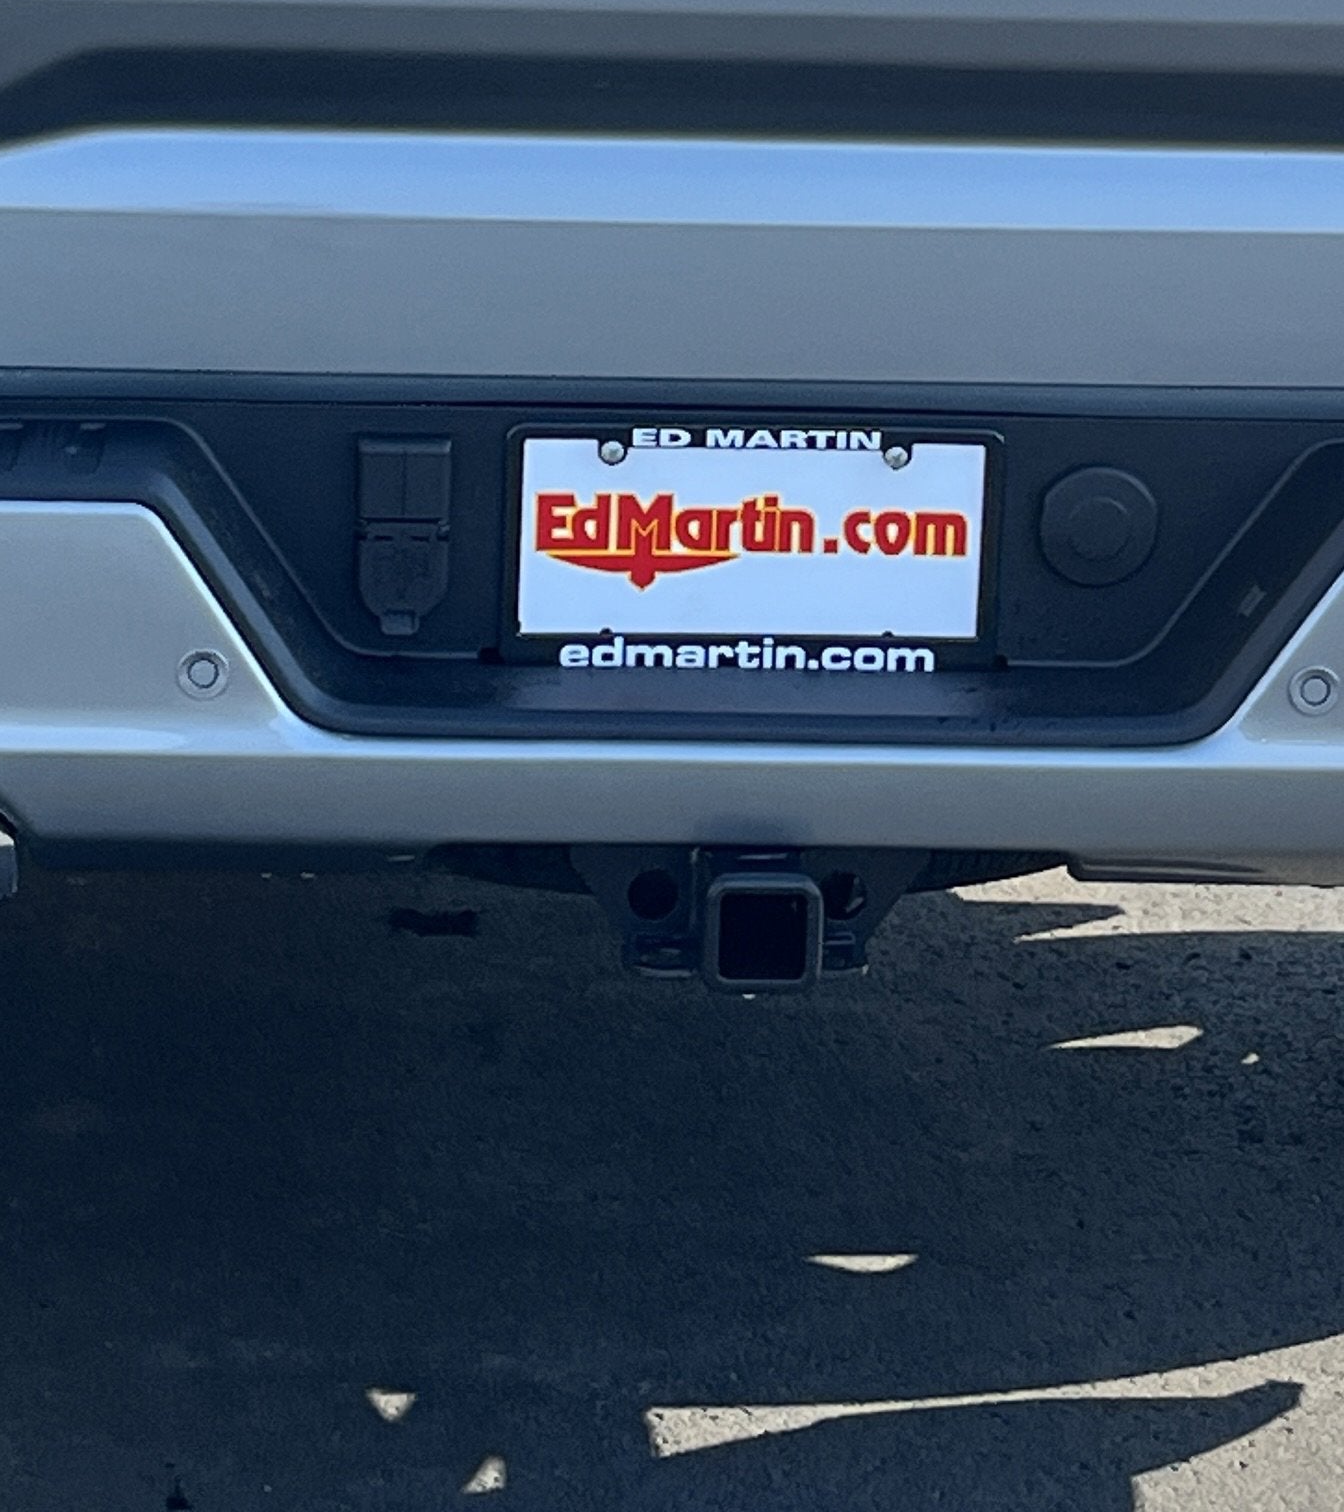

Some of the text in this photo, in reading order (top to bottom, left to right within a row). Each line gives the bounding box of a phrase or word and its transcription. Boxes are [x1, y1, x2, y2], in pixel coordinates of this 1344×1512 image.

[631, 428, 882, 451] ED MARTIN
[535, 493, 968, 557] EdMartin.com
[559, 637, 936, 673] edmartin.com
